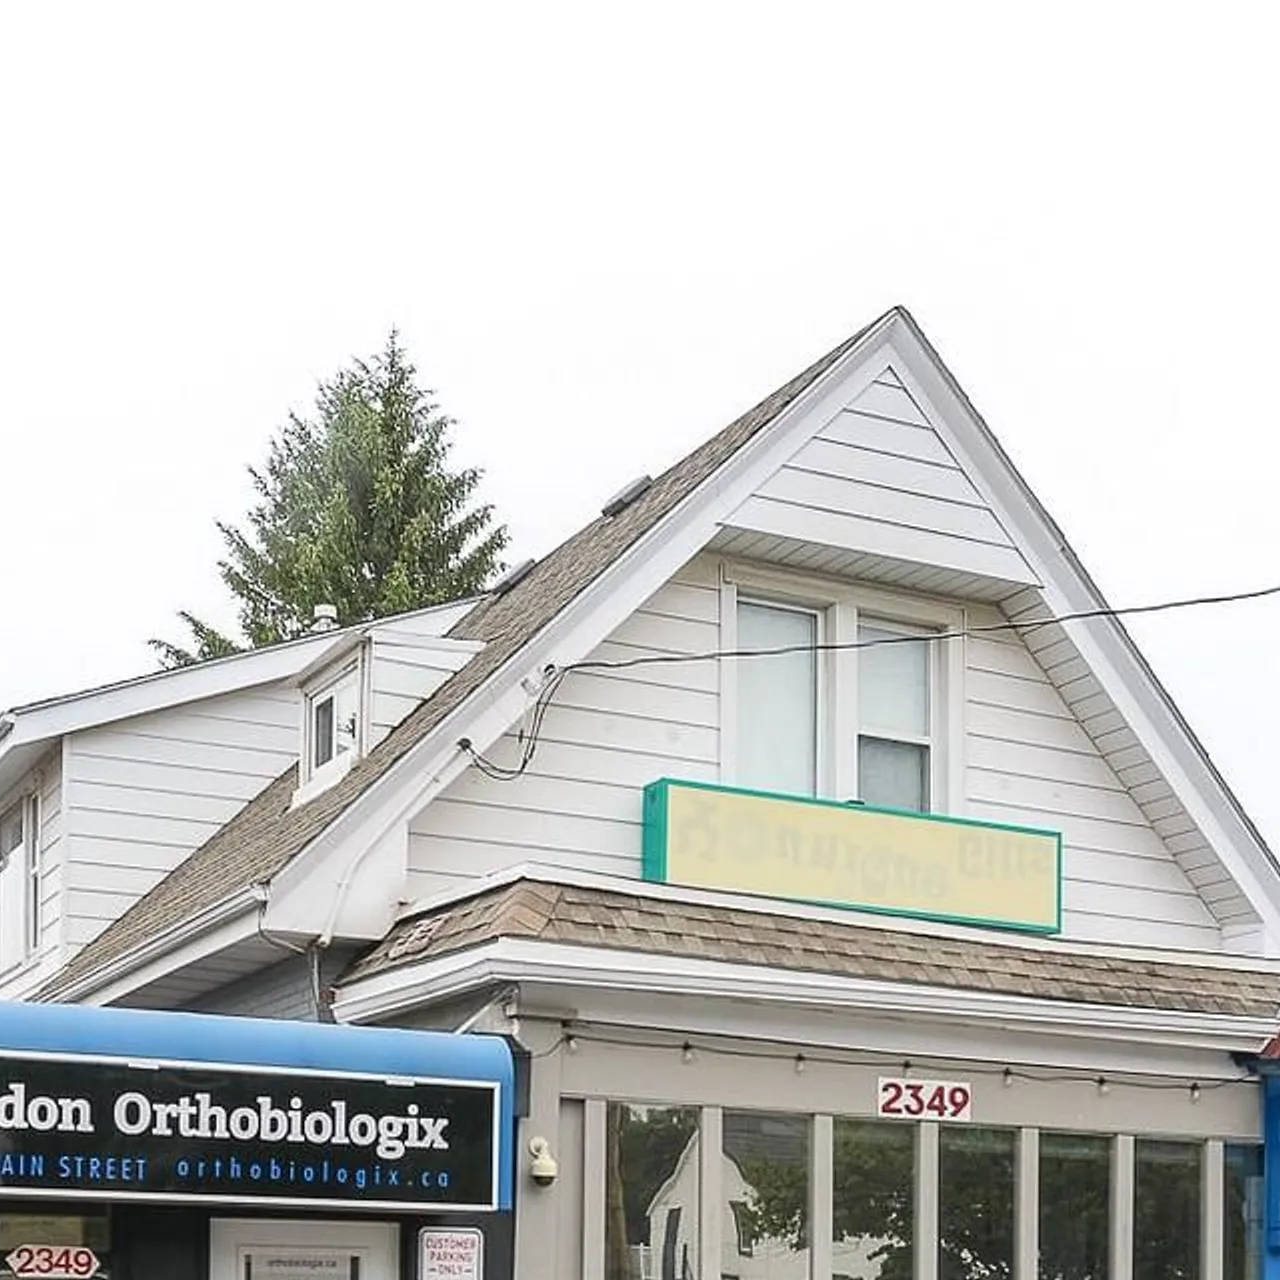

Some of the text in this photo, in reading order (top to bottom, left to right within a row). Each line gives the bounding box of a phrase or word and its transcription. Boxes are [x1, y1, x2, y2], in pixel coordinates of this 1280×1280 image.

[881, 1082, 970, 1117] 2349
[113, 1092, 450, 1160] Orthobiologix
[58, 1156, 147, 1180] STREET
[177, 1158, 450, 1189] orthobiologix.ca
[16, 1248, 92, 1275] 2349
[430, 1251, 472, 1262] PARKING
[439, 1264, 464, 1275] ONLY
